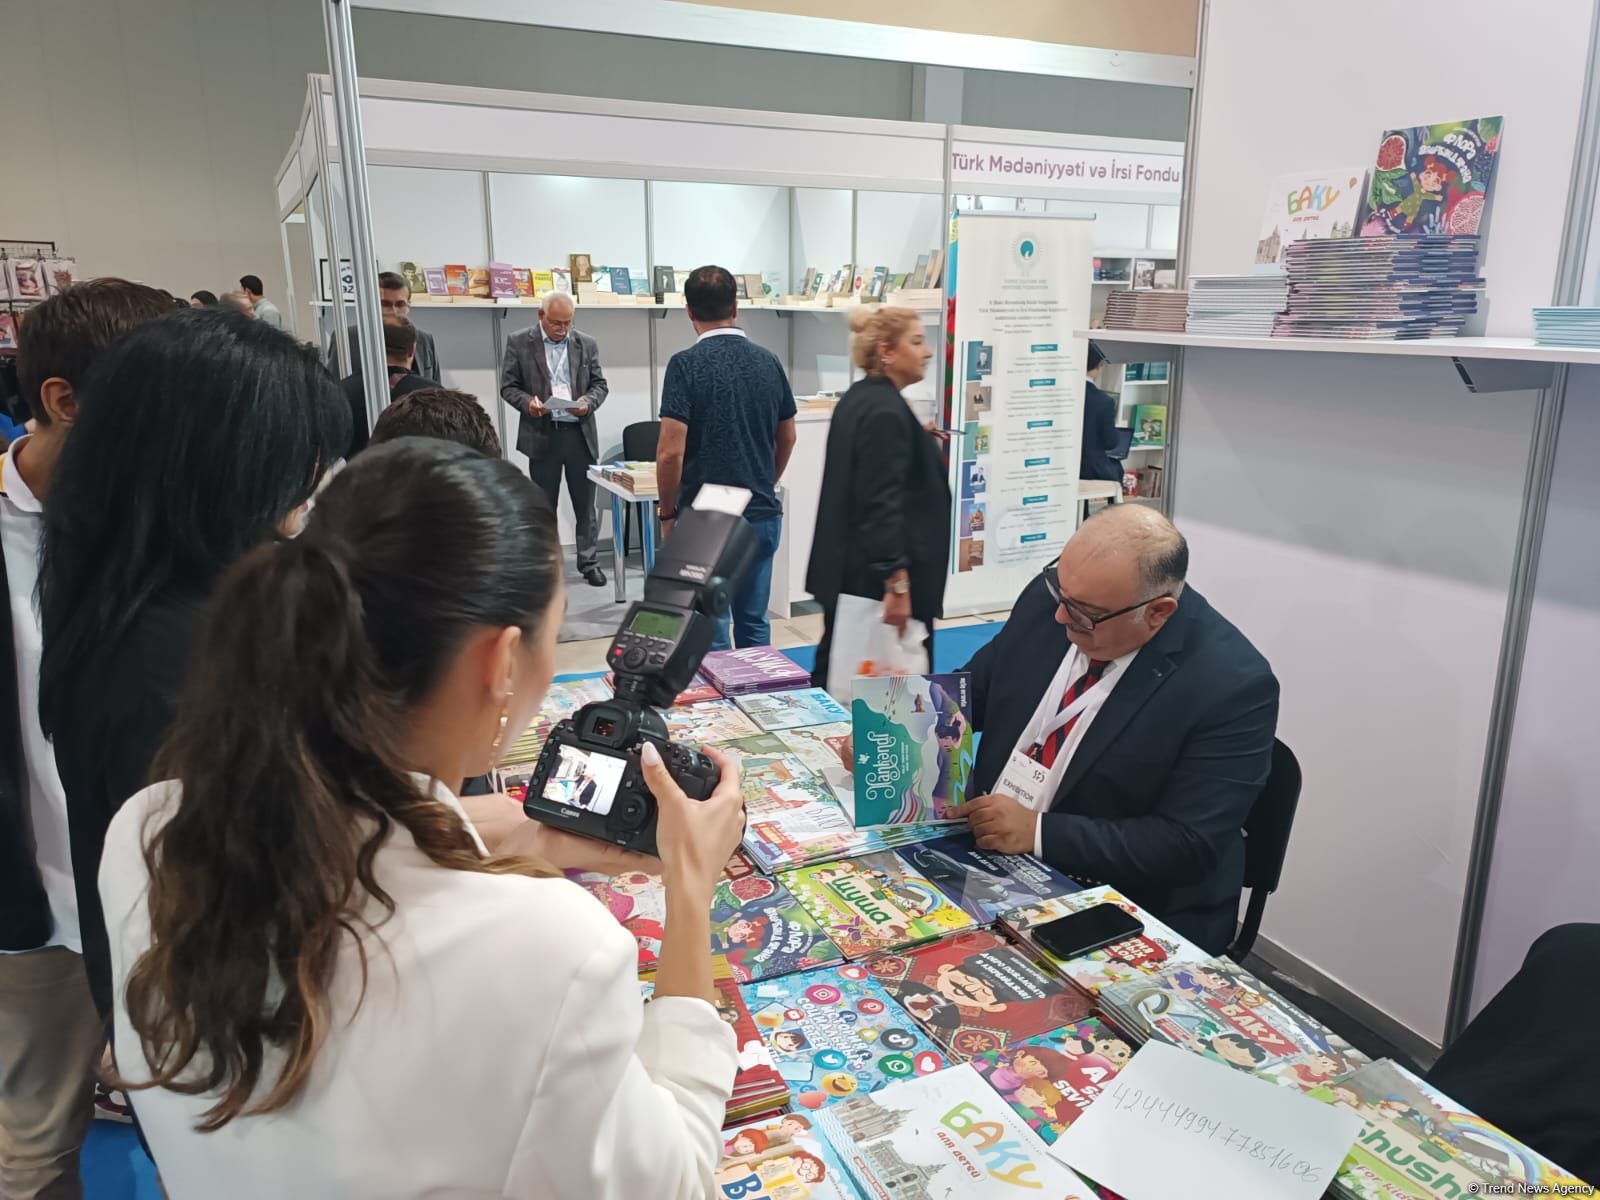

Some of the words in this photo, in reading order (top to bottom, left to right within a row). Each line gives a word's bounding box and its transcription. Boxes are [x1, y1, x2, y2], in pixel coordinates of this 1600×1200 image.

[952, 153, 984, 171] Türk
[989, 155, 1085, 180] Mədəniyyəti
[1089, 166, 1107, 179] və
[1111, 159, 1132, 180] İrsi
[1136, 164, 1180, 183] Fondu
[1288, 185, 1341, 215] БАКУ
[811, 693, 845, 715] БАКУ
[1003, 778, 1034, 802] EXHIBITOR
[1220, 1004, 1285, 1046] БАКУ
[939, 1100, 1043, 1189] БАКУ
[1358, 1121, 1484, 1200] hush
